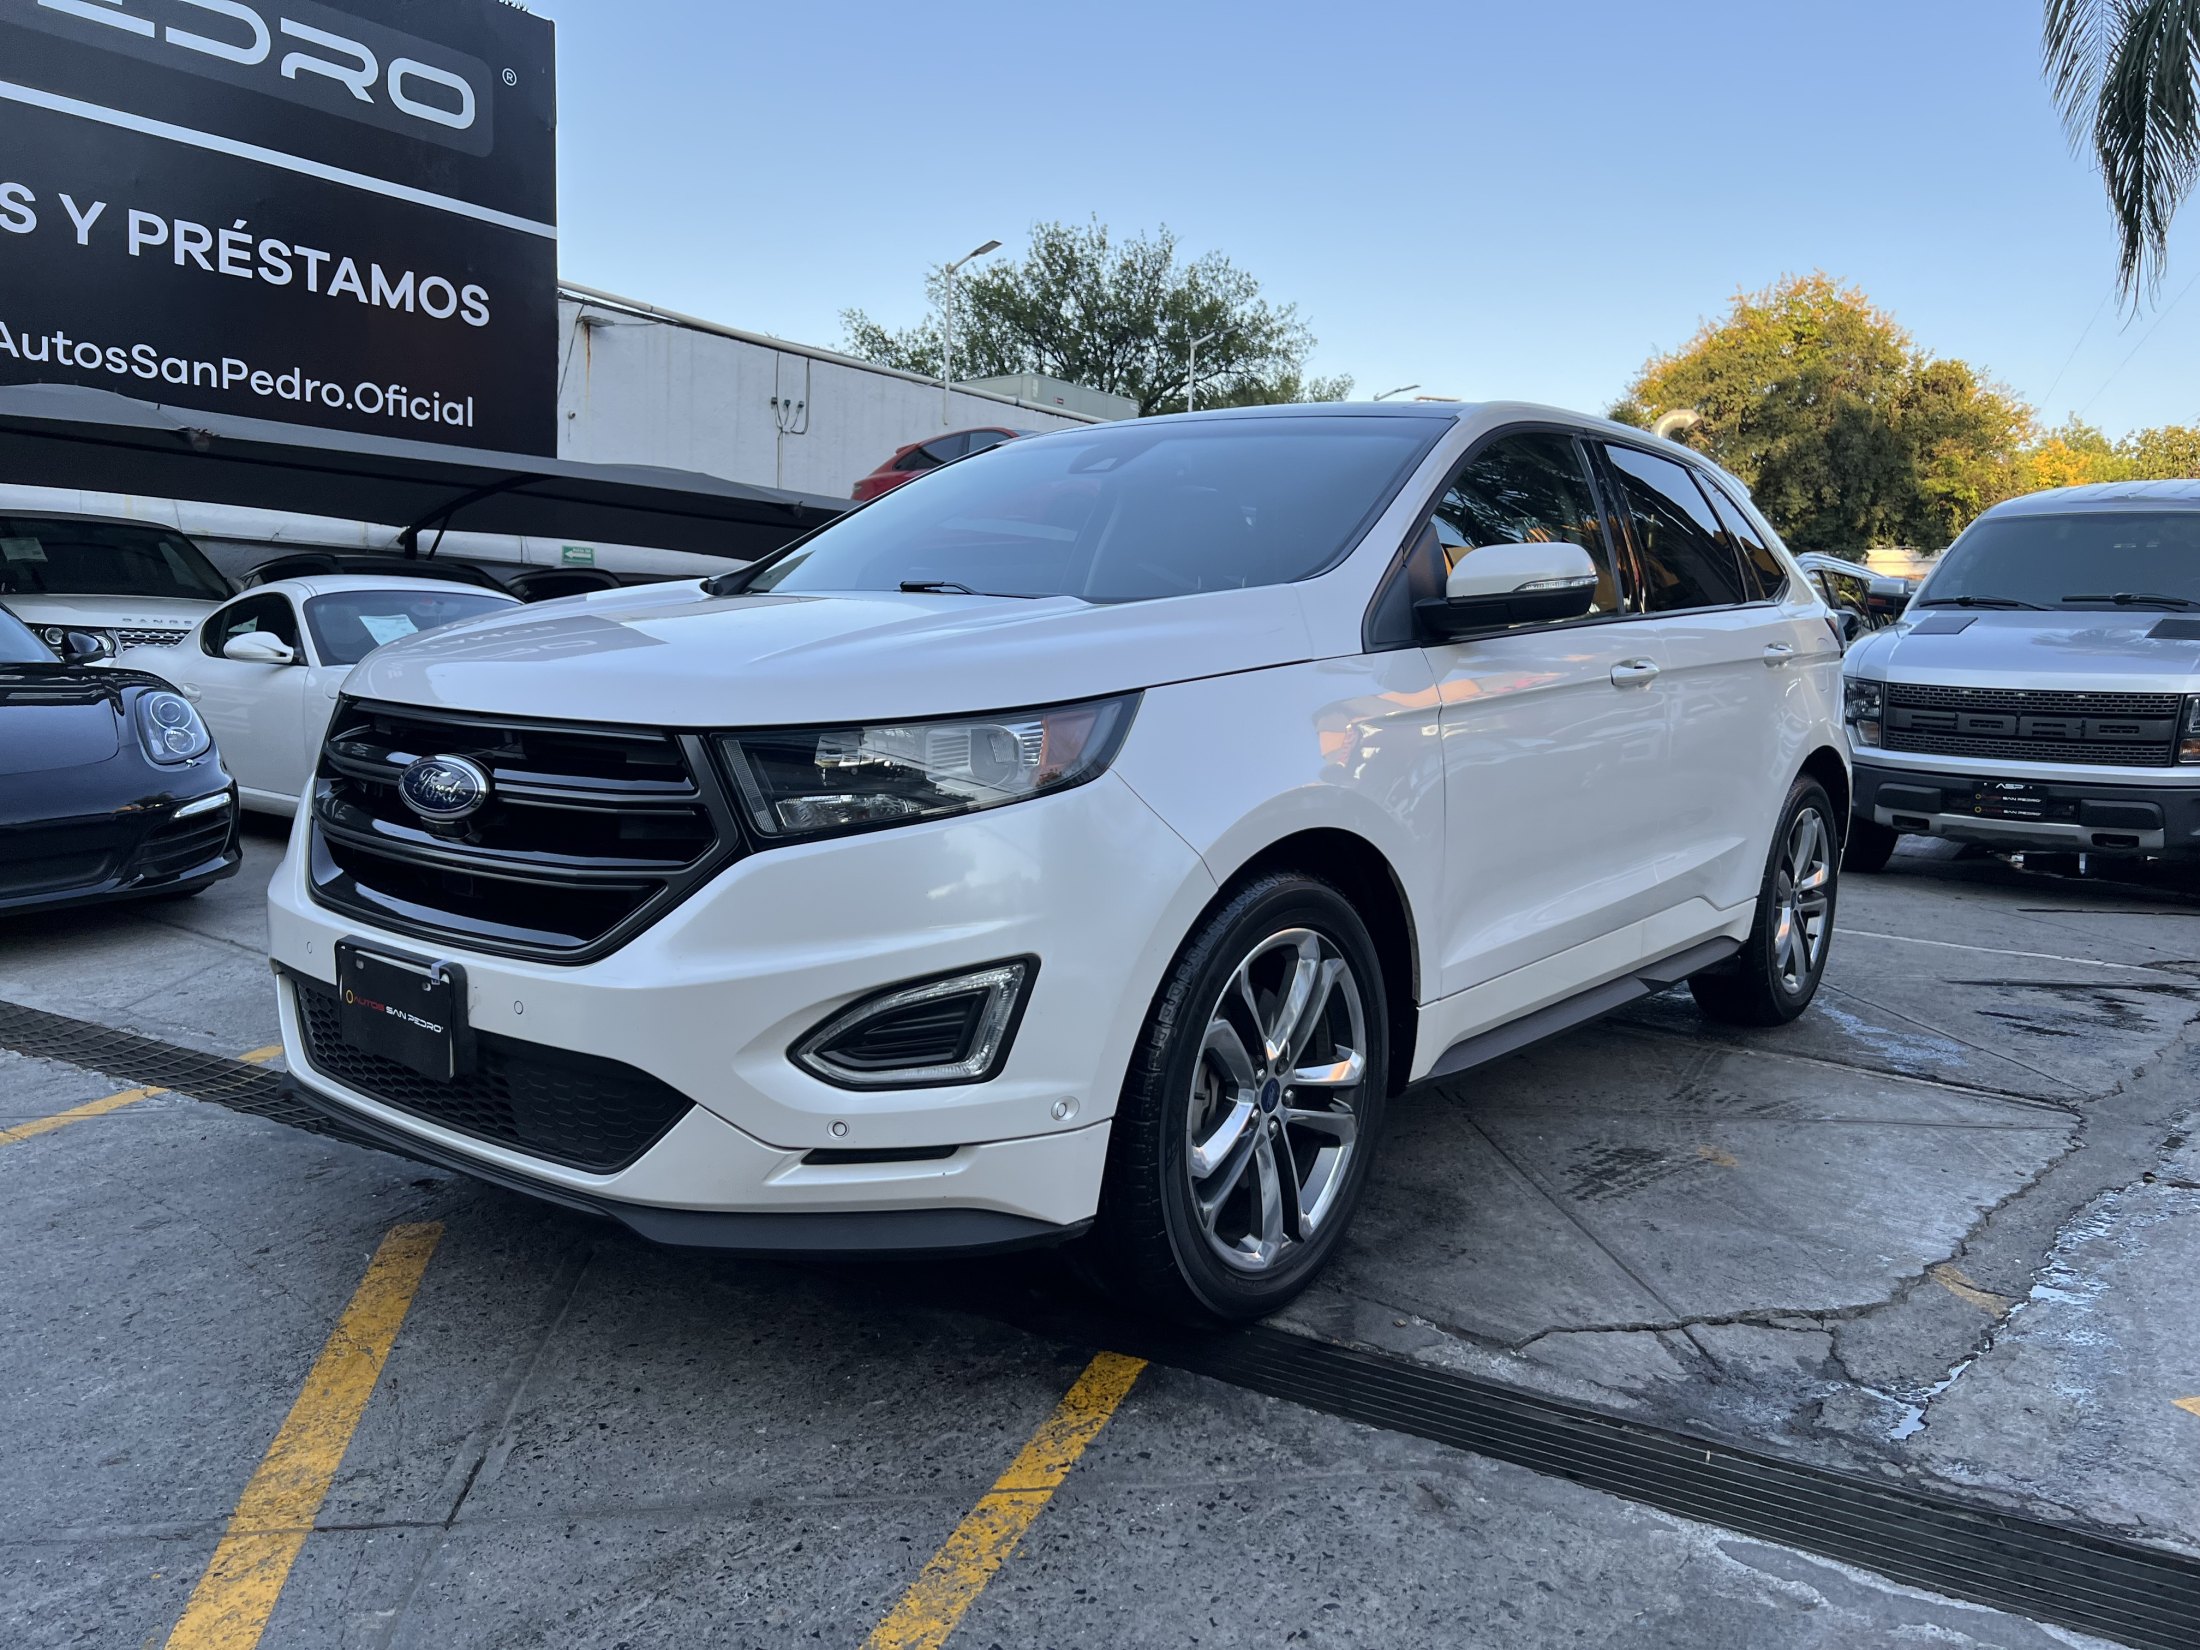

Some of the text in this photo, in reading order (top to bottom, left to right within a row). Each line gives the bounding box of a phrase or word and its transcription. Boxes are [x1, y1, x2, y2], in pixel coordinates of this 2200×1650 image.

[58, 192, 107, 246] Y
[128, 208, 490, 327] PRÉSTAMOS
[122, 617, 192, 625] RANGE
[1887, 707, 2176, 741] FORD
[413, 767, 467, 803] Ford
[386, 1005, 406, 1019] SAN
